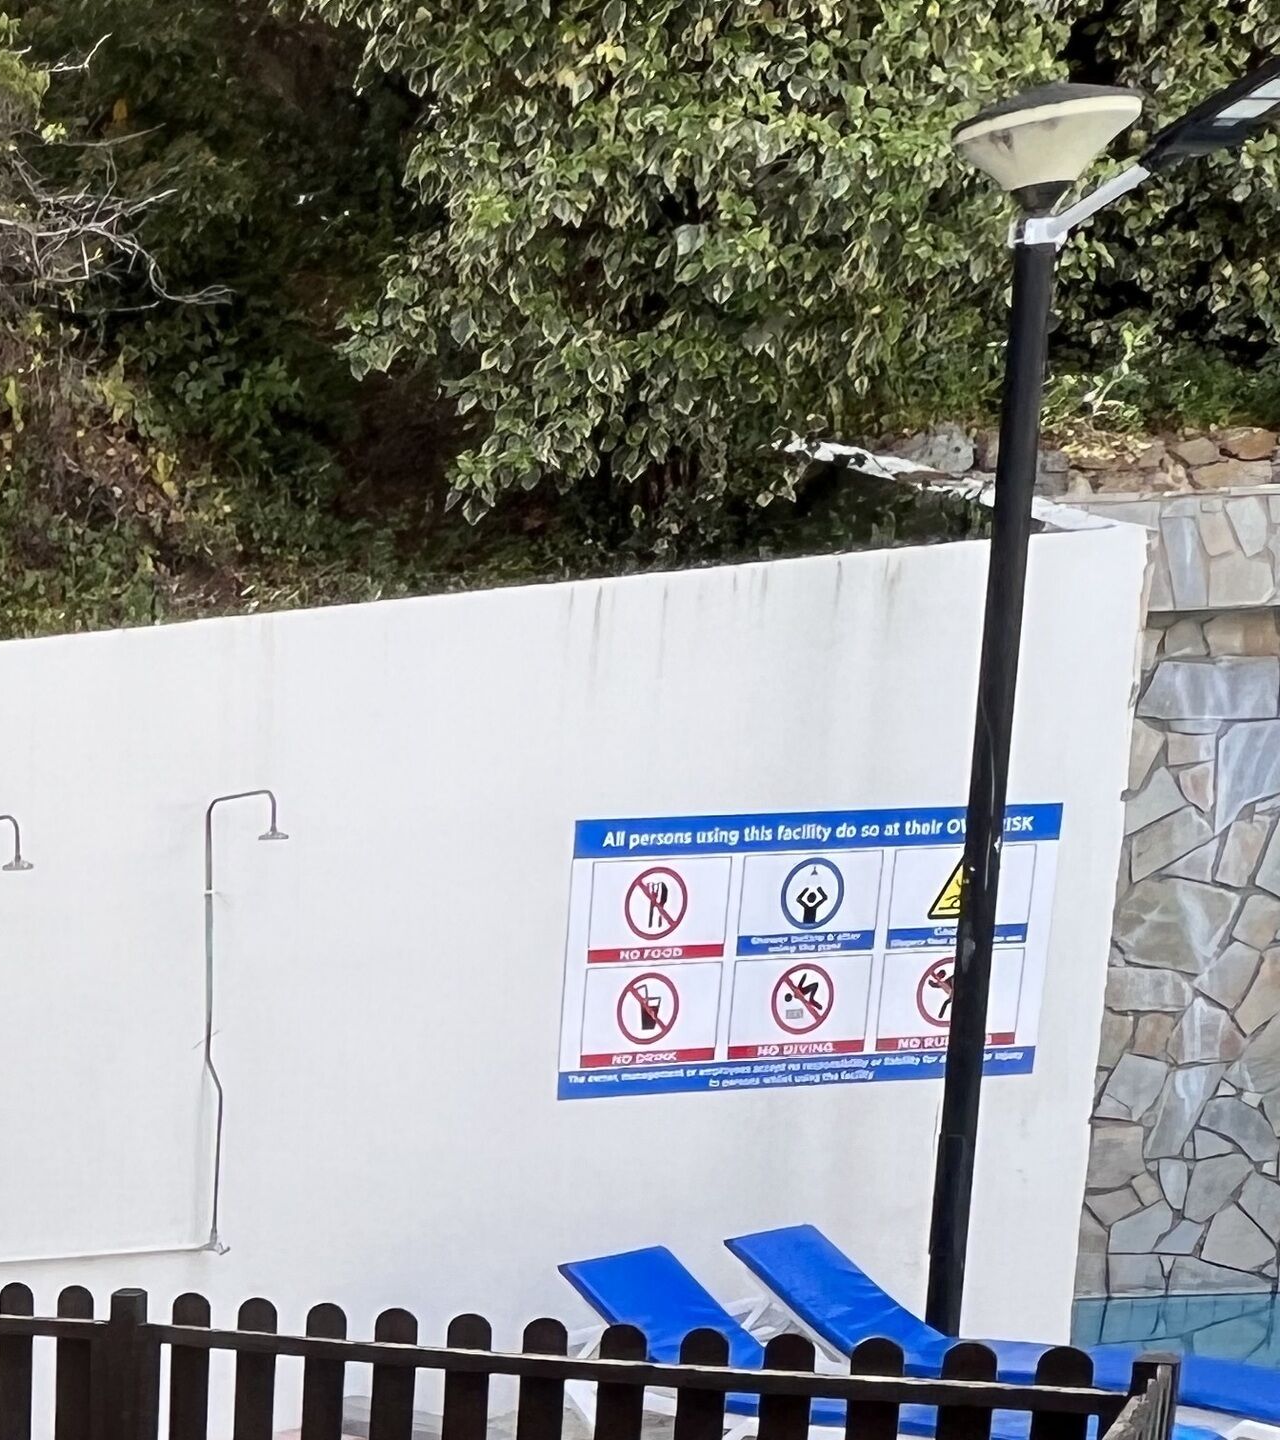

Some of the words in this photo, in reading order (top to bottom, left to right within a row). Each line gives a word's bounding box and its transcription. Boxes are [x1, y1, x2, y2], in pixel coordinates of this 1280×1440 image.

[602, 831, 626, 847] All
[628, 832, 692, 850] persons
[696, 827, 740, 846] using
[743, 824, 773, 842] this
[777, 820, 832, 843] facility
[835, 821, 857, 838] do
[860, 825, 879, 838] so
[883, 822, 900, 836] at
[904, 818, 944, 836] their
[1002, 815, 1035, 832] ISK
[619, 949, 640, 960] NO
[642, 947, 683, 959] FOOD
[756, 1044, 780, 1056] NO
[782, 1041, 835, 1055] DIVING
[897, 1037, 921, 1049] NO
[611, 1054, 633, 1065] NO
